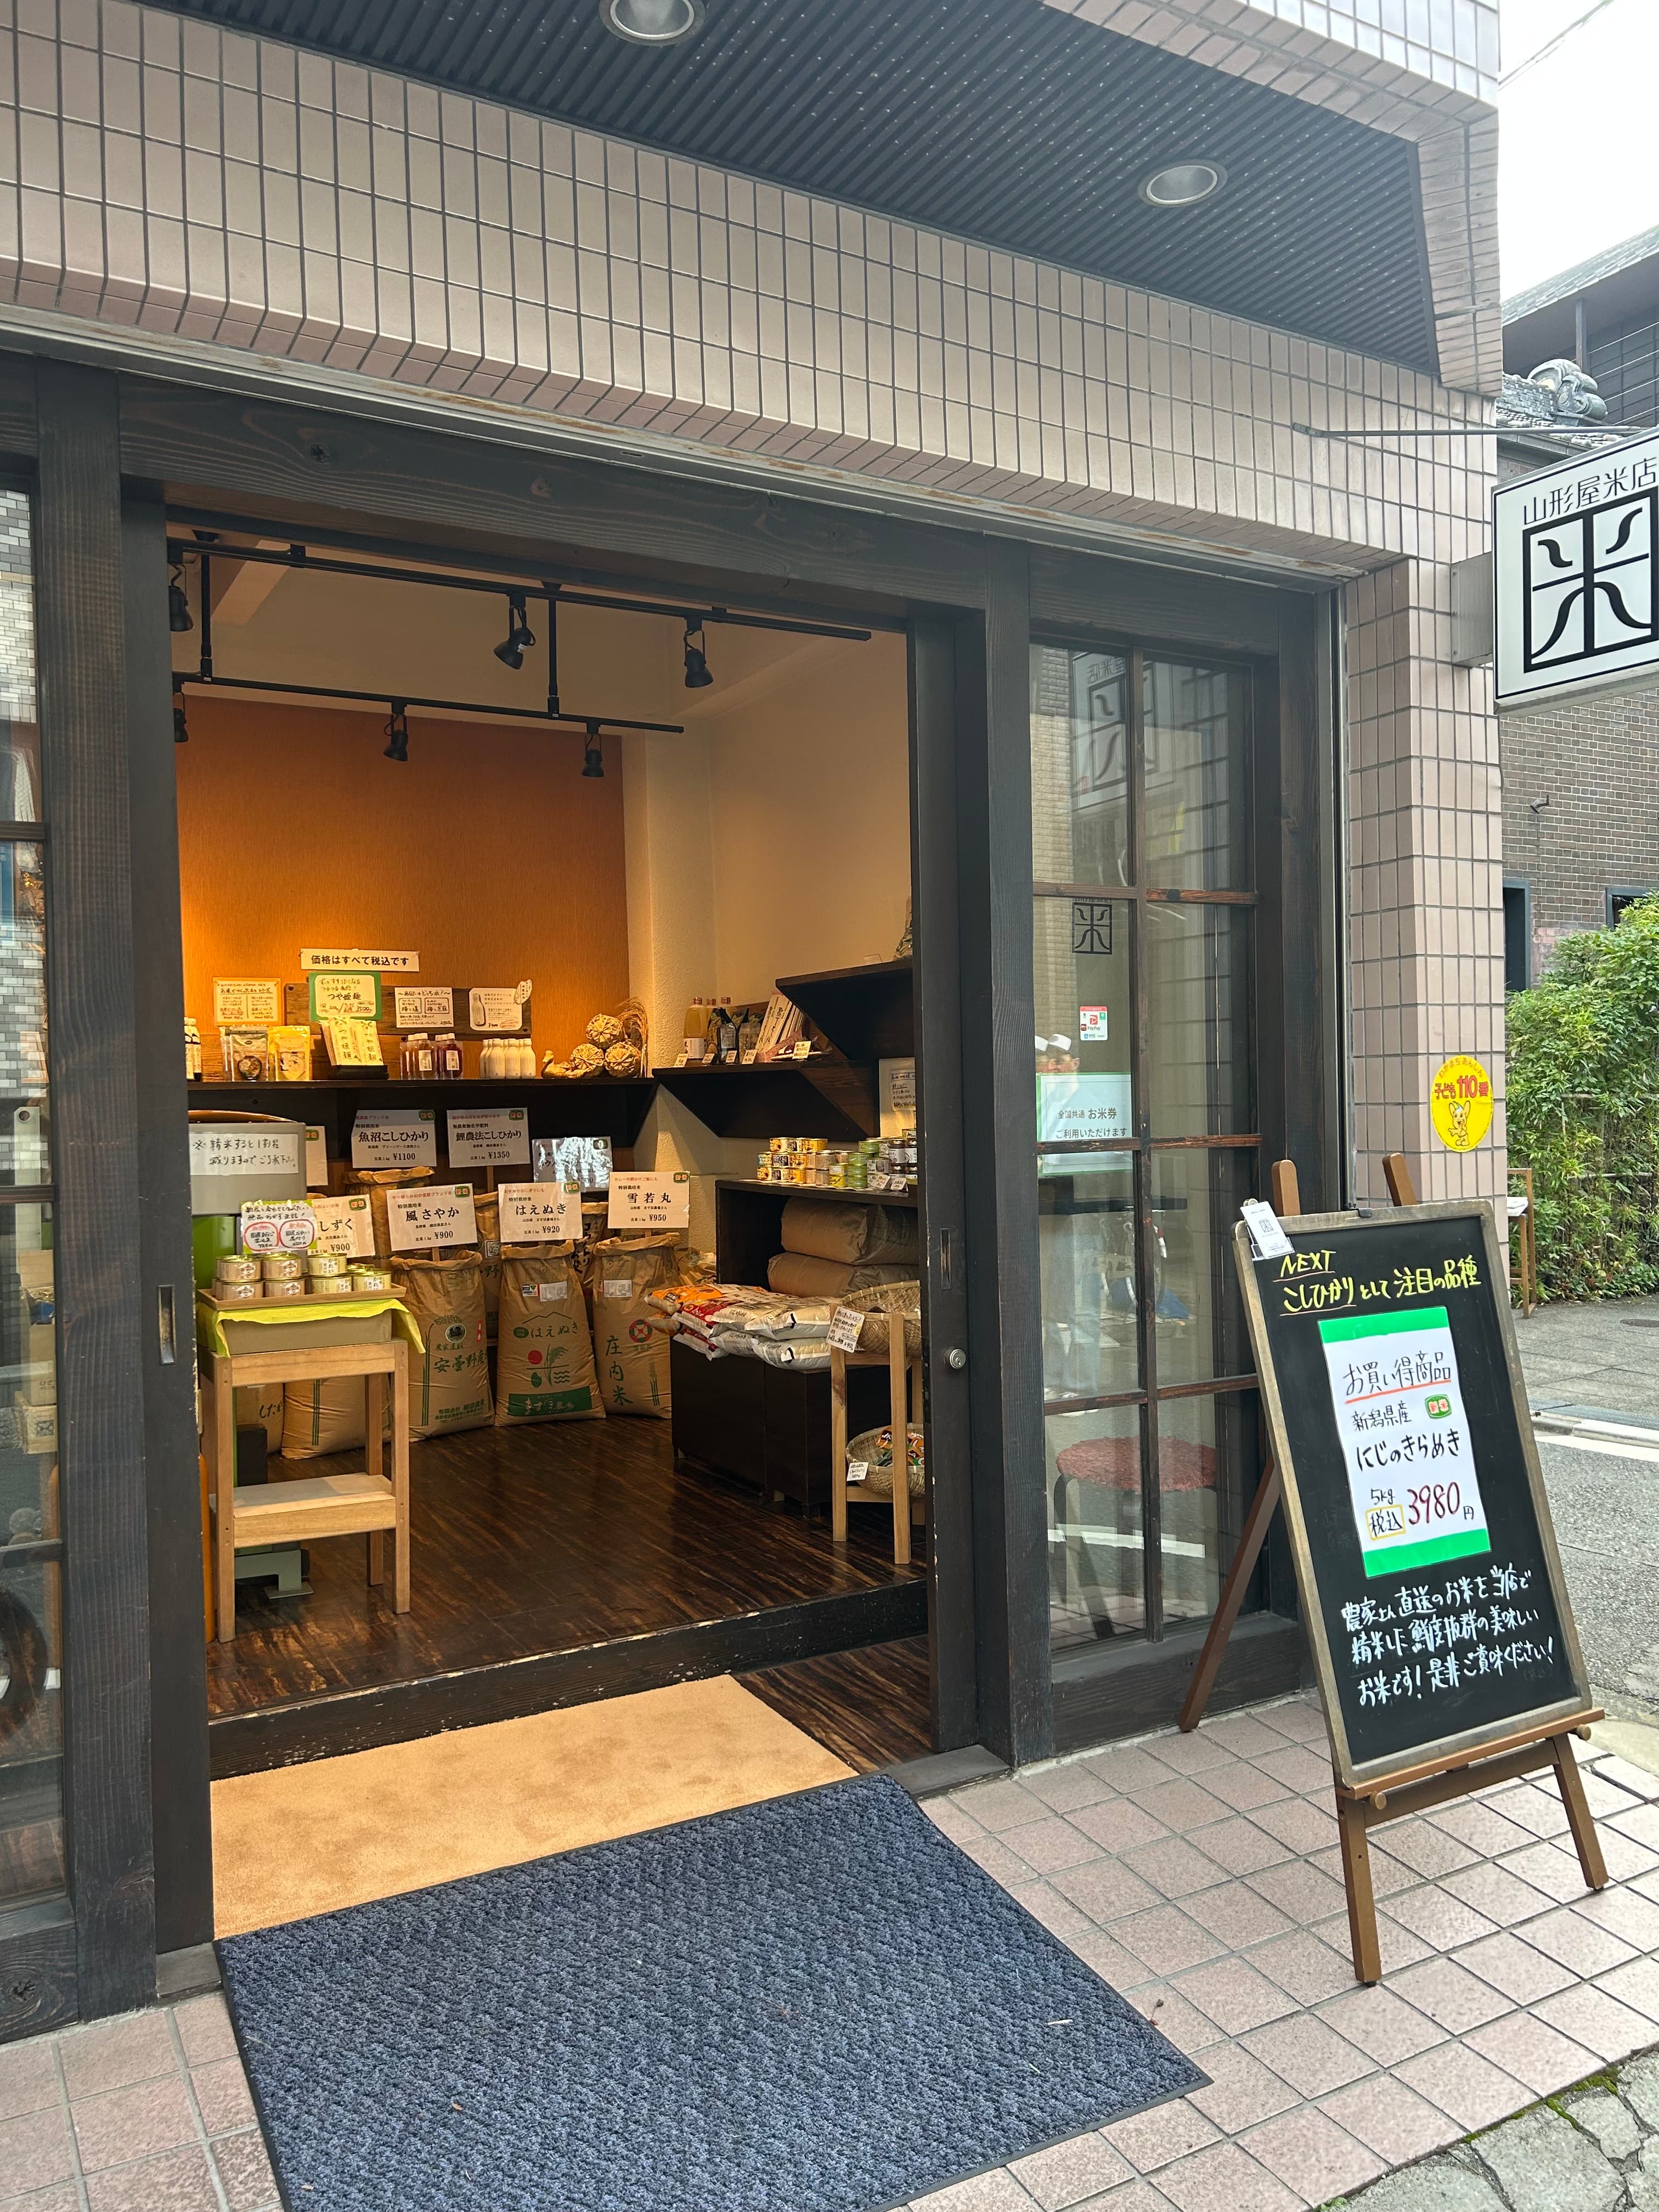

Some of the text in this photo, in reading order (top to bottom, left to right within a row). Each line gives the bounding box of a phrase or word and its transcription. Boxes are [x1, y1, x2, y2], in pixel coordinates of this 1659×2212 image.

[1523, 457, 1657, 525] 山形屋米店
[312, 955, 409, 966] 価格はすべて税込です
[1438, 1057, 1483, 1077] わがまちあんしん
[1058, 1107, 1117, 1119] 全国共通 お米券
[358, 1131, 428, 1142] 魚沼こしひかり
[456, 1130, 521, 1141] 鯉農法こしひかり
[1056, 1127, 1127, 1138] ご利用いただけます
[627, 1193, 672, 1203] 雪若丸
[406, 1207, 459, 1222] 風さやか
[516, 1204, 567, 1215] はえぬき
[319, 1218, 353, 1232] しずく
[434, 1231, 453, 1239] ¥900
[330, 1243, 350, 1252] ¥900
[1280, 1250, 1337, 1278] NEXT
[1283, 1255, 1482, 1312] こしひかりとして注目の品種
[531, 1321, 578, 1338] はえぬき
[606, 1335, 634, 1406] 庄内米
[1343, 1350, 1451, 1396] お買い得商品
[1429, 1398, 1450, 1414] 新米
[1351, 1400, 1413, 1432] 新潟県産
[1356, 1429, 1460, 1471] にじのきらめき
[1370, 1488, 1395, 1506] 5kg
[1369, 1509, 1403, 1537] 税込
